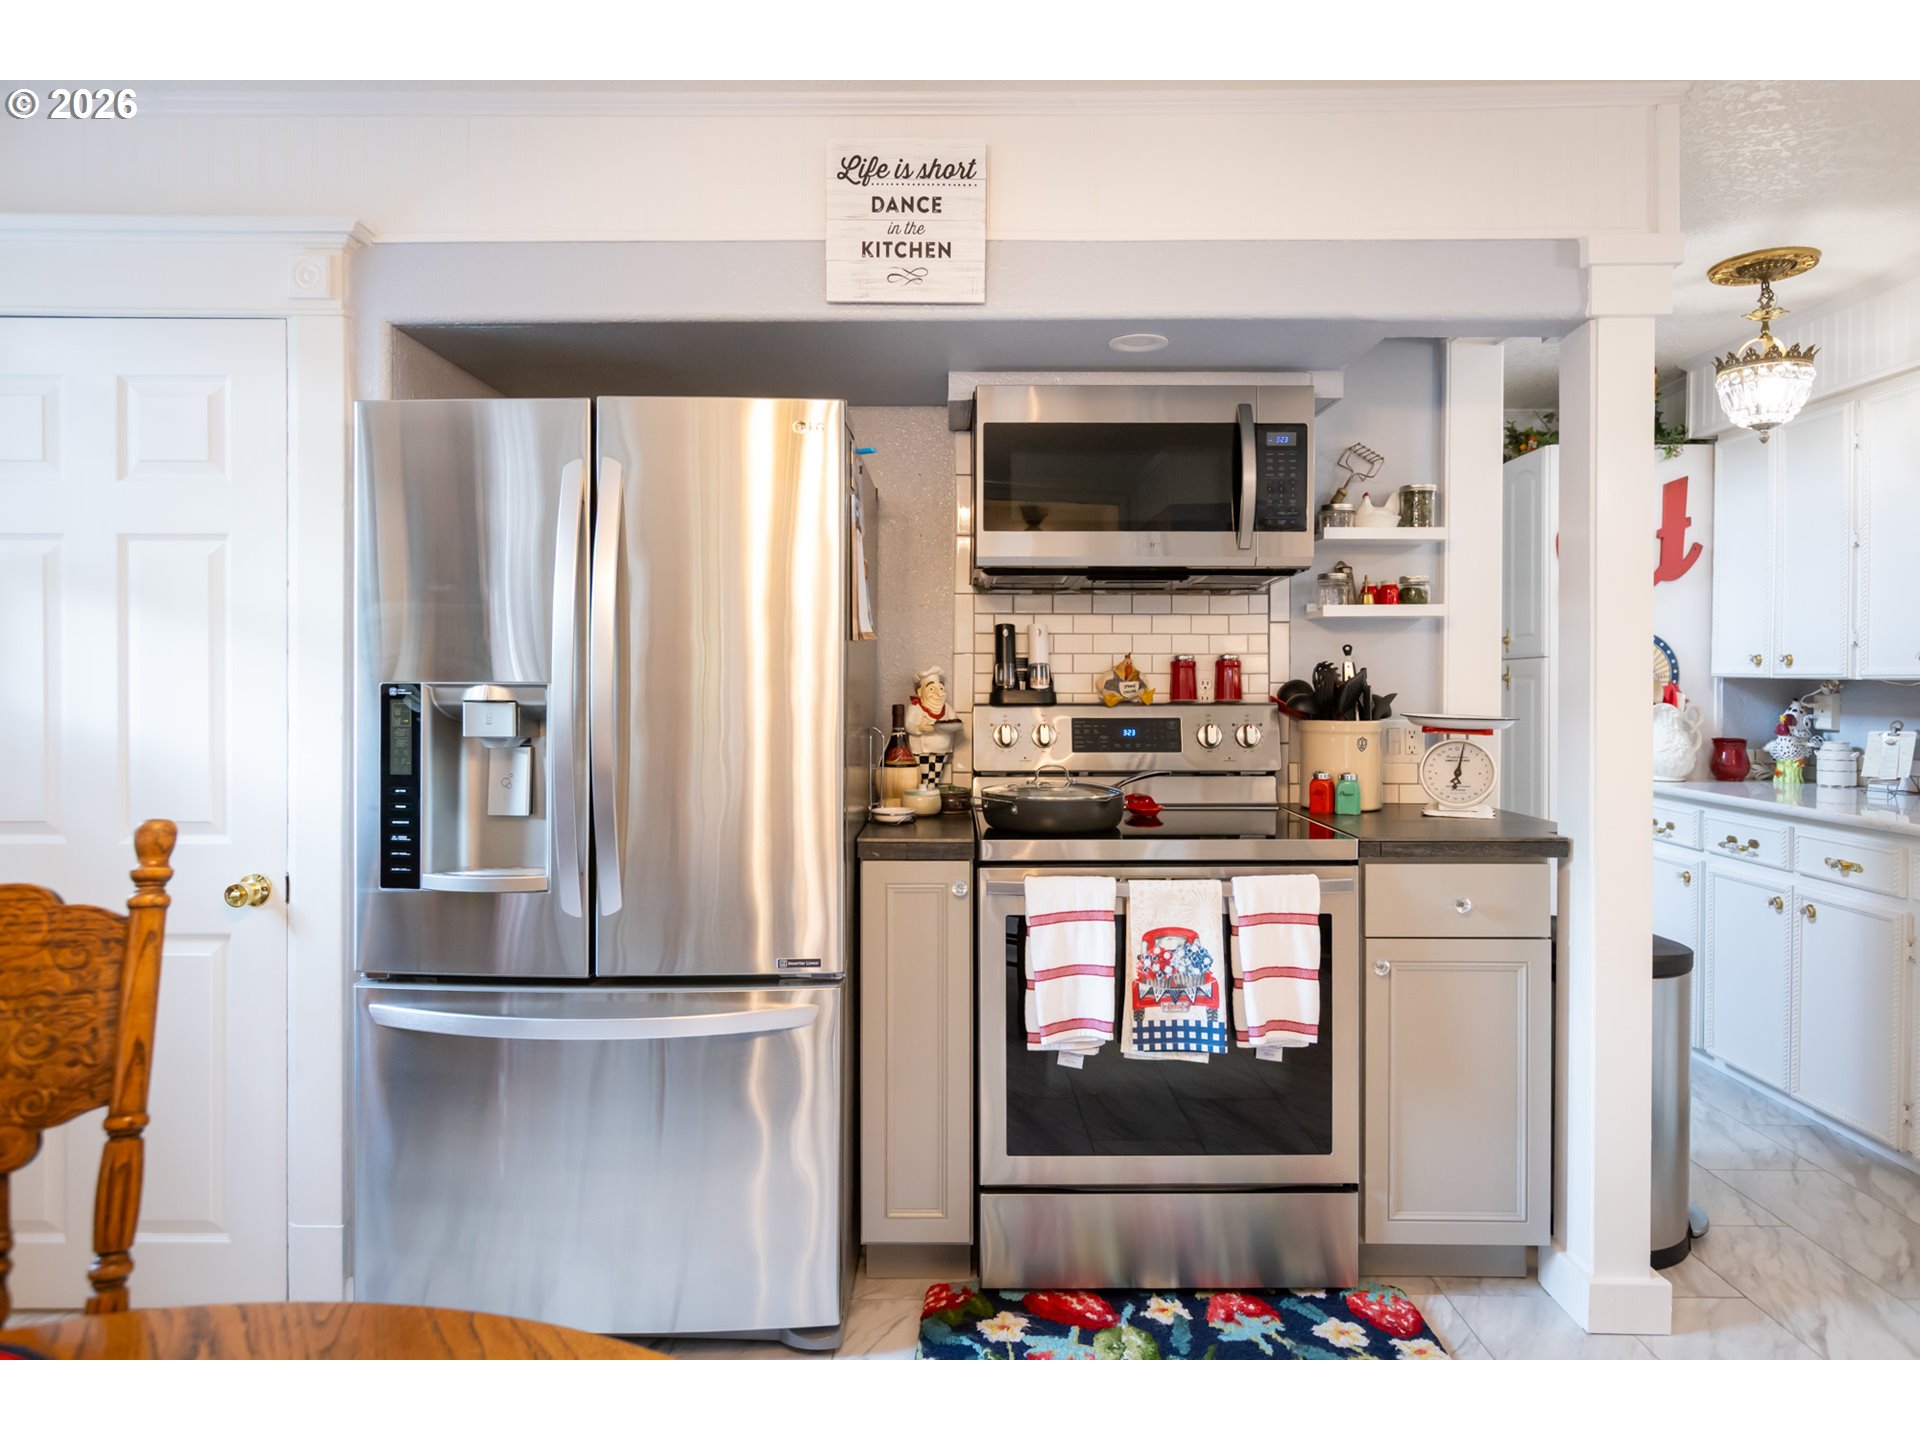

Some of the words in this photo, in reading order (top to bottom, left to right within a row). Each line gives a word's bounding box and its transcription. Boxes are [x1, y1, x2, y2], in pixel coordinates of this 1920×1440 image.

[837, 155, 891, 187] Life
[894, 158, 914, 179] is
[916, 158, 978, 180] short
[871, 196, 943, 214] DANCE
[887, 222, 902, 235] in
[903, 221, 926, 235] the
[861, 241, 952, 259] KITCHEN
